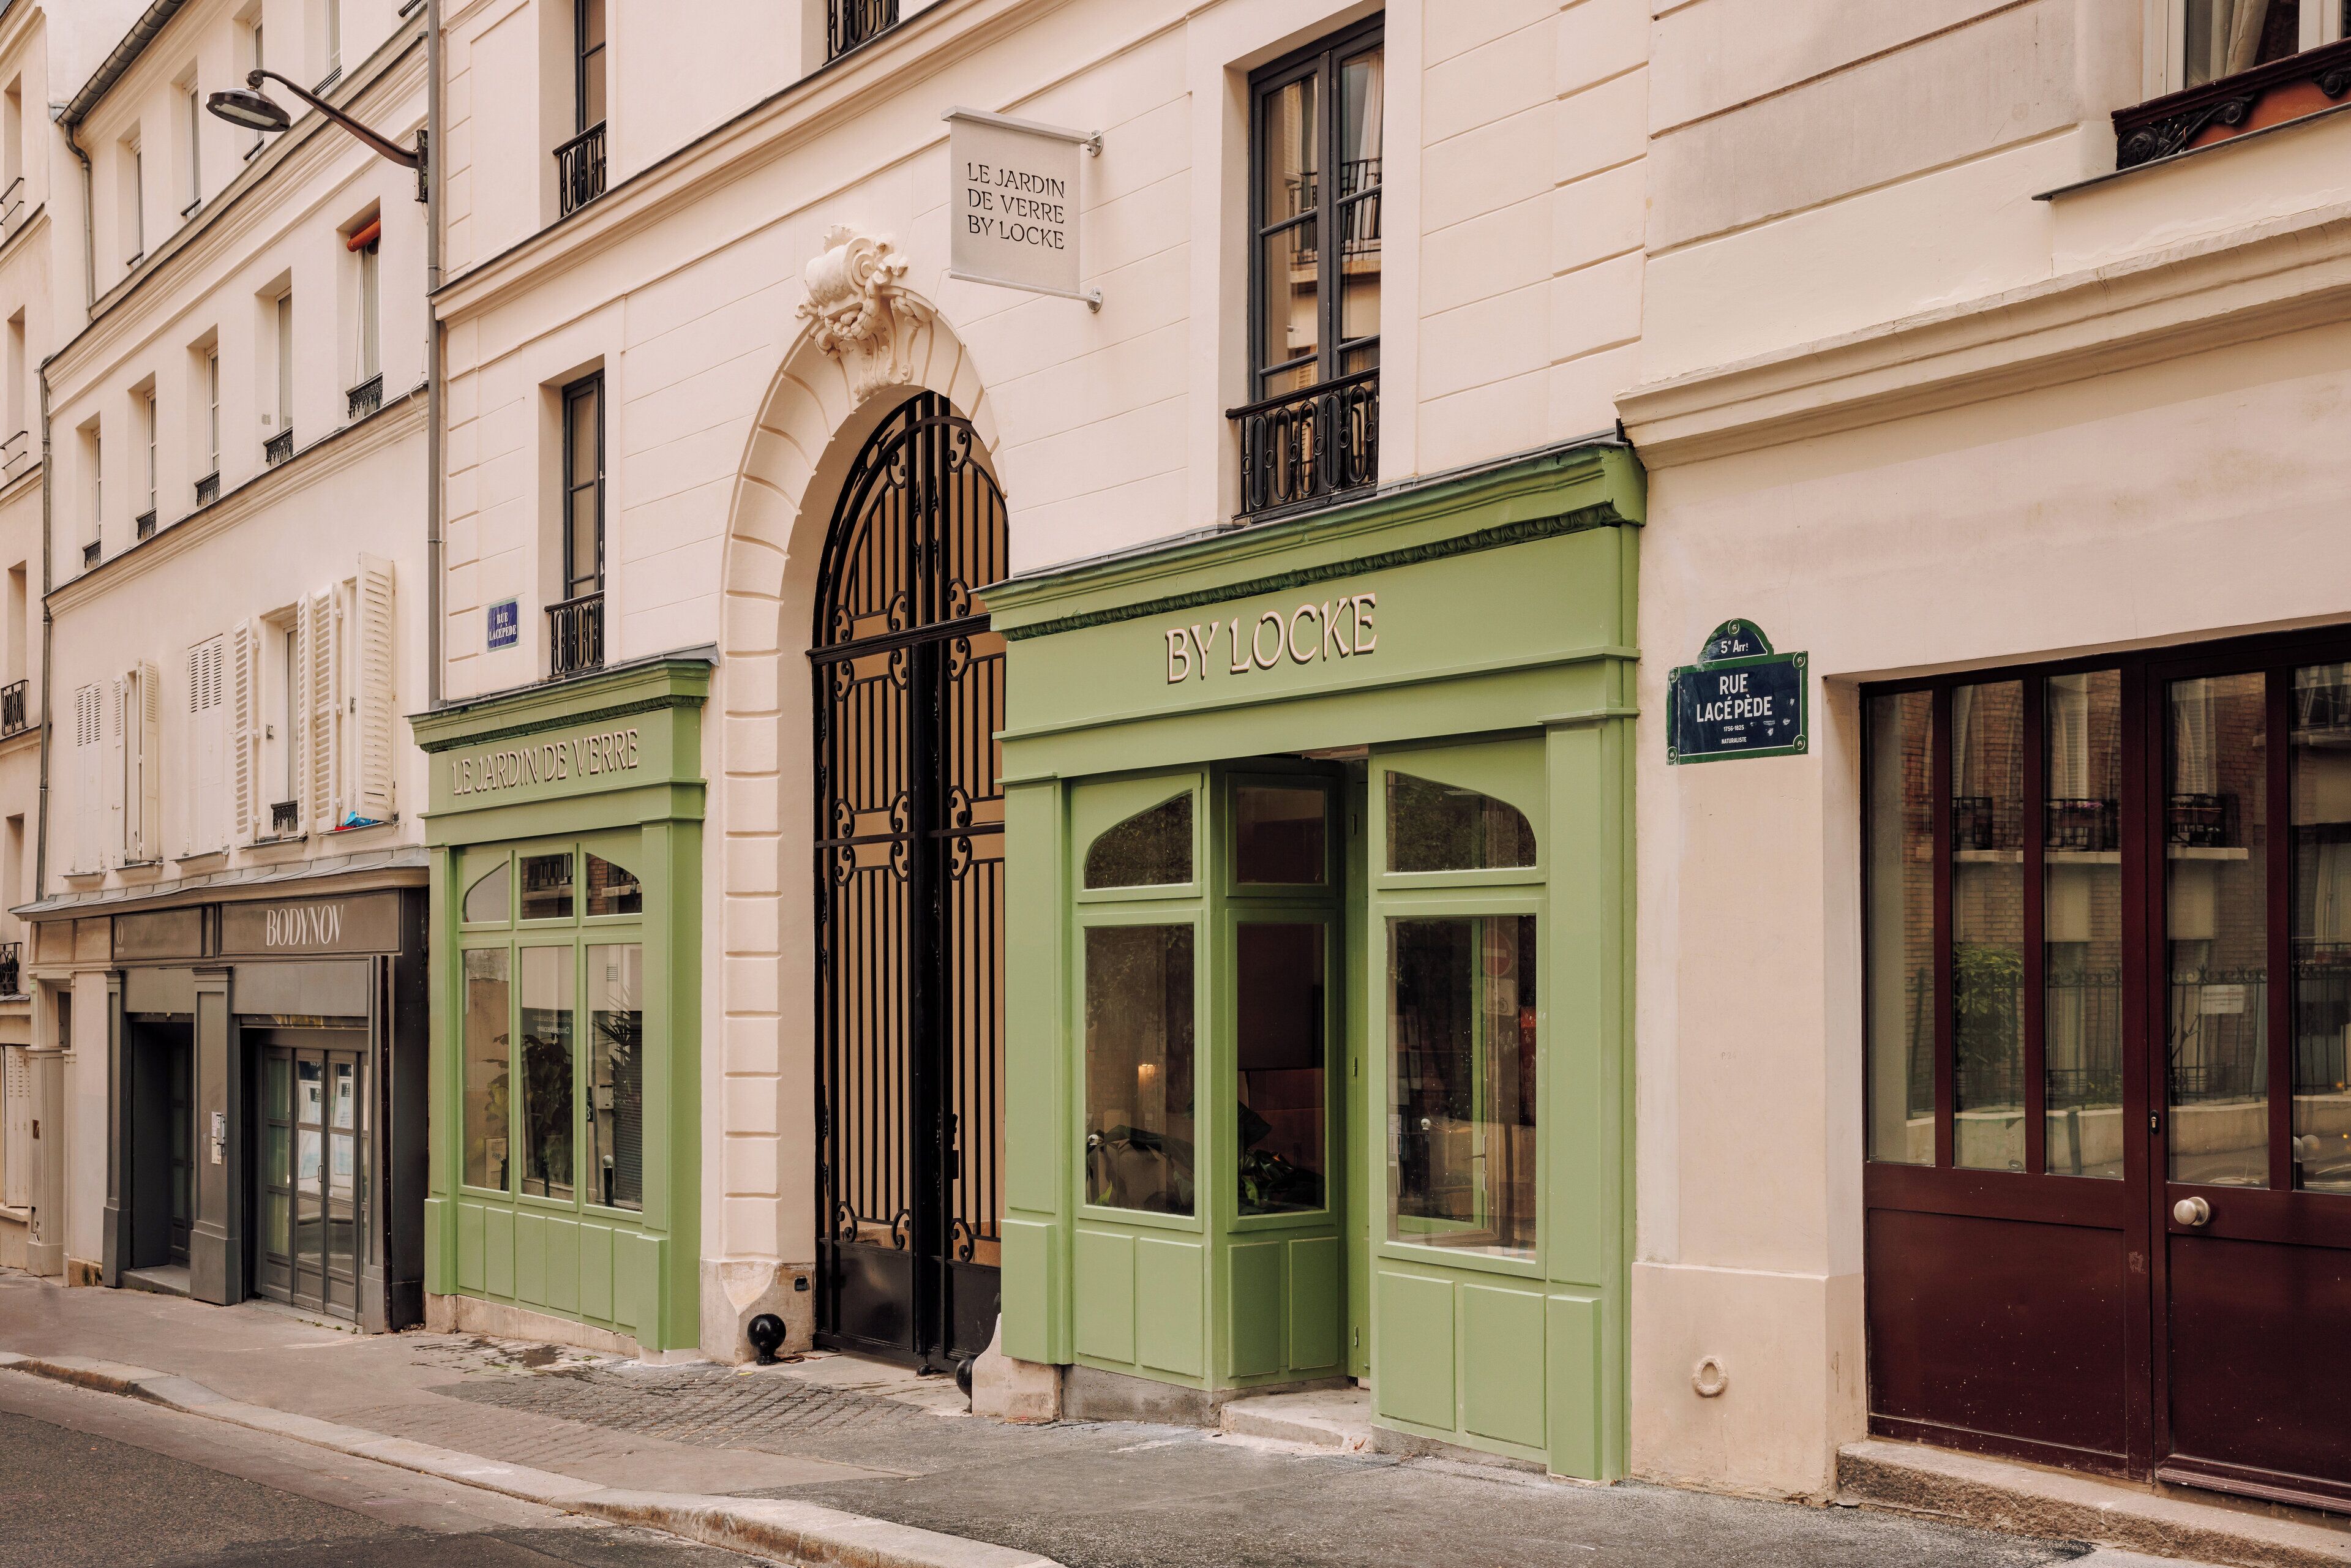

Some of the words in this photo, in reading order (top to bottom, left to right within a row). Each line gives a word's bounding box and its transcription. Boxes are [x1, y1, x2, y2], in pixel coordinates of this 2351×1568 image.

[967, 162, 990, 184] LE
[995, 169, 1064, 198] JARDIN
[968, 189, 993, 210] DE
[1000, 195, 1064, 224] VERRE
[968, 214, 994, 236] BY
[999, 221, 1064, 250] LOCKE
[489, 623, 516, 640] LACÉPÈDE
[497, 612, 508, 624] RUE
[1165, 621, 1219, 685] BY
[1229, 593, 1377, 675] LOCKE
[1719, 673, 1749, 695] RUE
[1697, 694, 1772, 722] LACÉPÈDE
[452, 758, 471, 795] LE
[475, 746, 538, 792] JARDIN
[543, 741, 567, 782] DE
[572, 729, 639, 777] VERRE
[266, 904, 344, 946] BODYNOV
